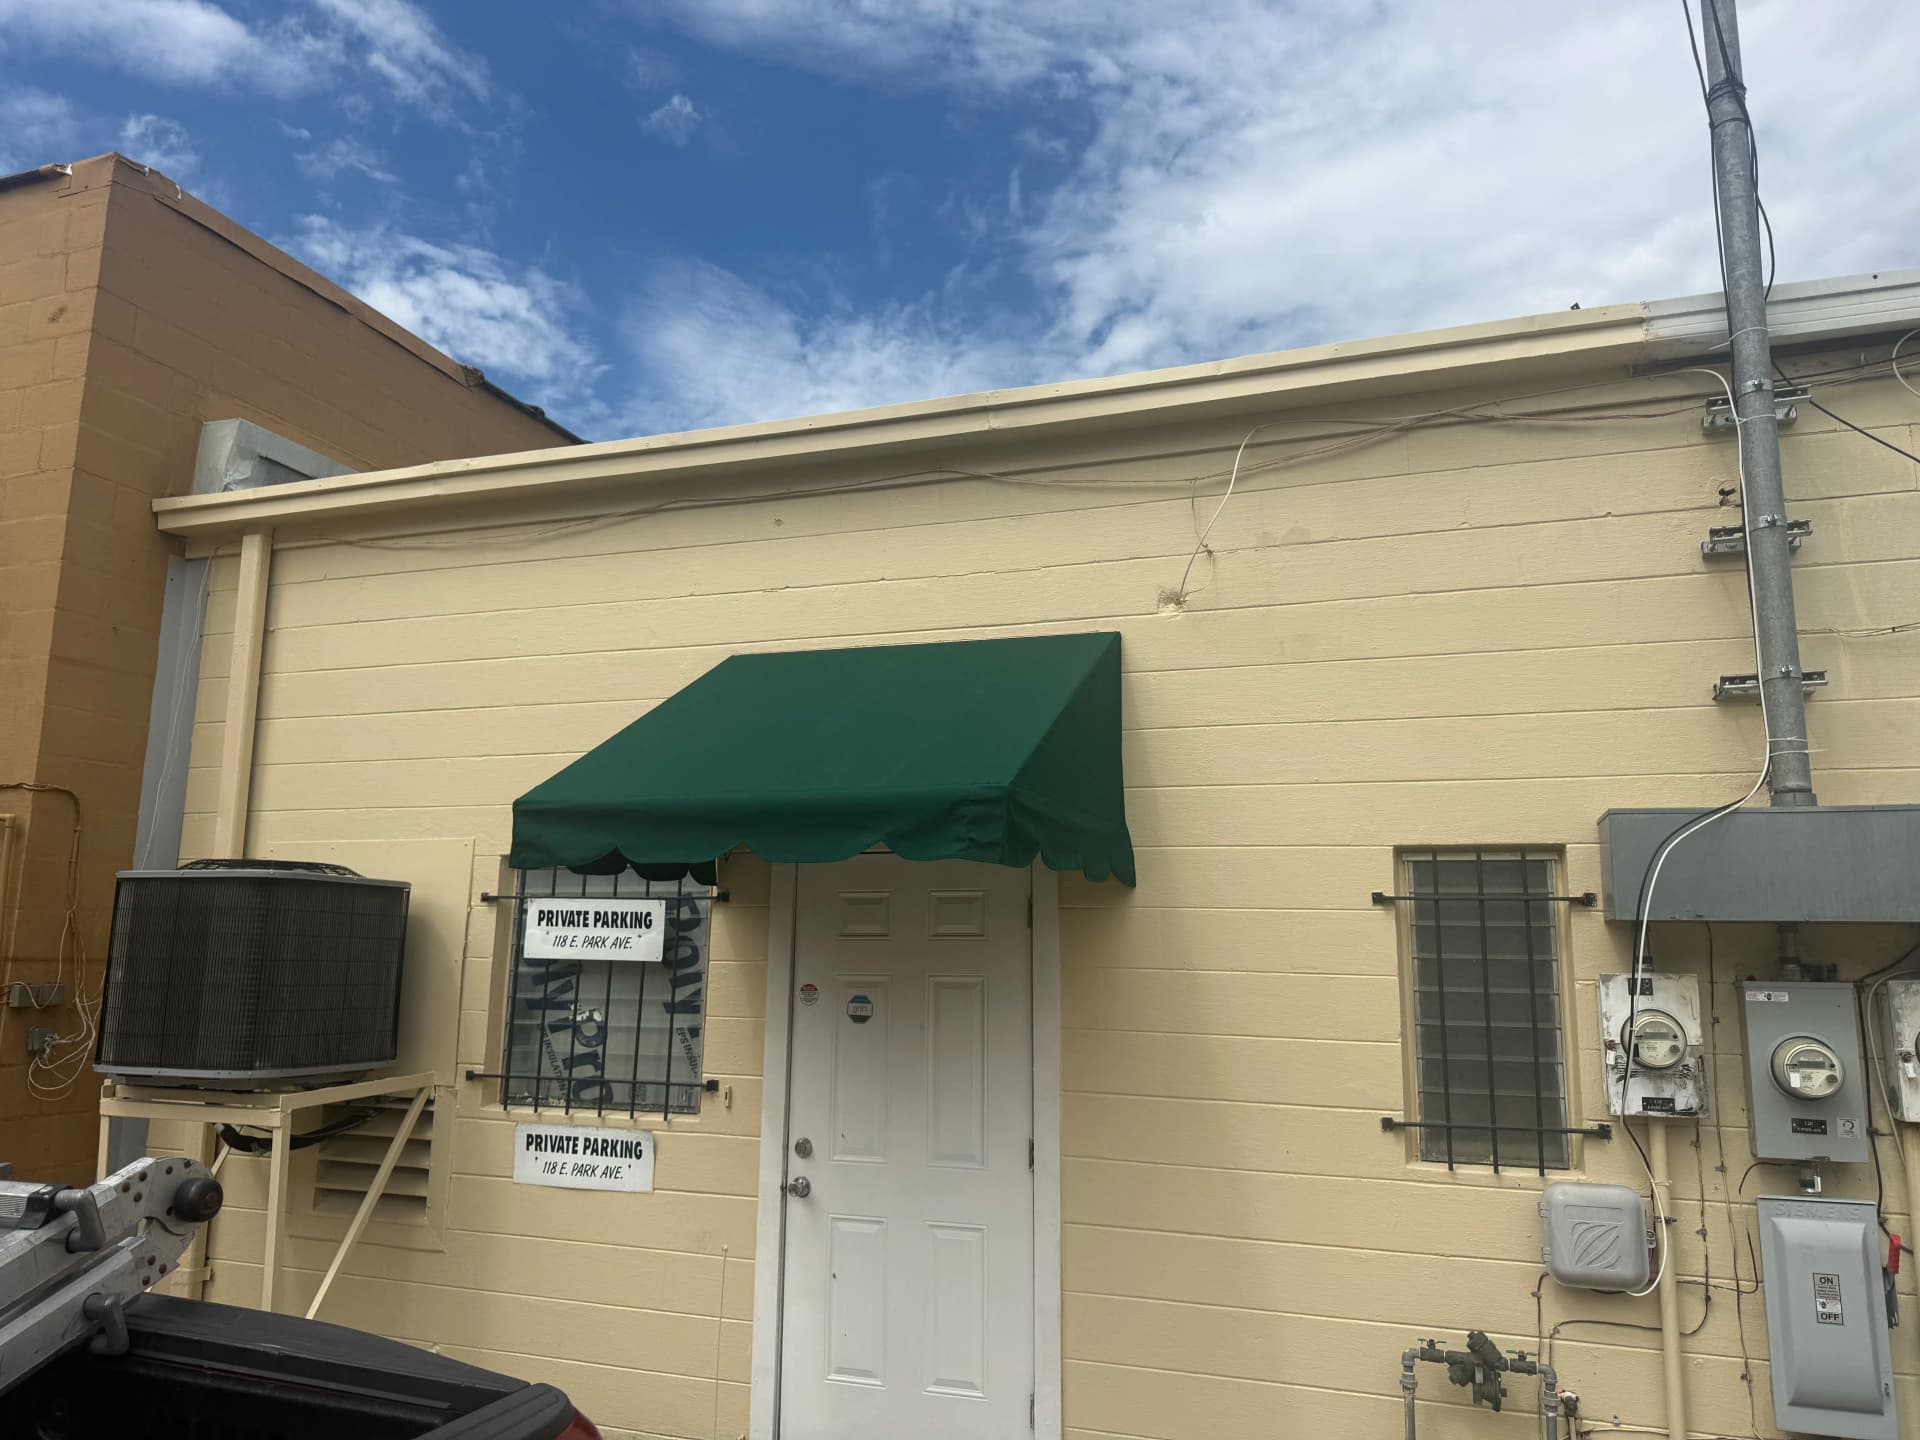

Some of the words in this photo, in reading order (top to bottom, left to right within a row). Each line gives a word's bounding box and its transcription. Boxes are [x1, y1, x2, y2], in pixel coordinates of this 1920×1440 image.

[537, 909, 590, 928] PRIVATE
[593, 910, 653, 930] PARKING
[552, 935, 568, 948] 118
[569, 935, 579, 948] E.
[581, 935, 610, 949] PARK
[609, 936, 633, 950] AVE.
[525, 1133, 579, 1155] PRIVATE
[582, 1137, 643, 1160] PARKING
[542, 1161, 558, 1175] 118
[559, 1162, 568, 1175] E.
[570, 1162, 599, 1178] PARK
[599, 1165, 624, 1180] AVE.
[1775, 1202, 1863, 1220] SIEMENS
[1819, 1276, 1834, 1285] ON
[1820, 1312, 1840, 1321] OFF
